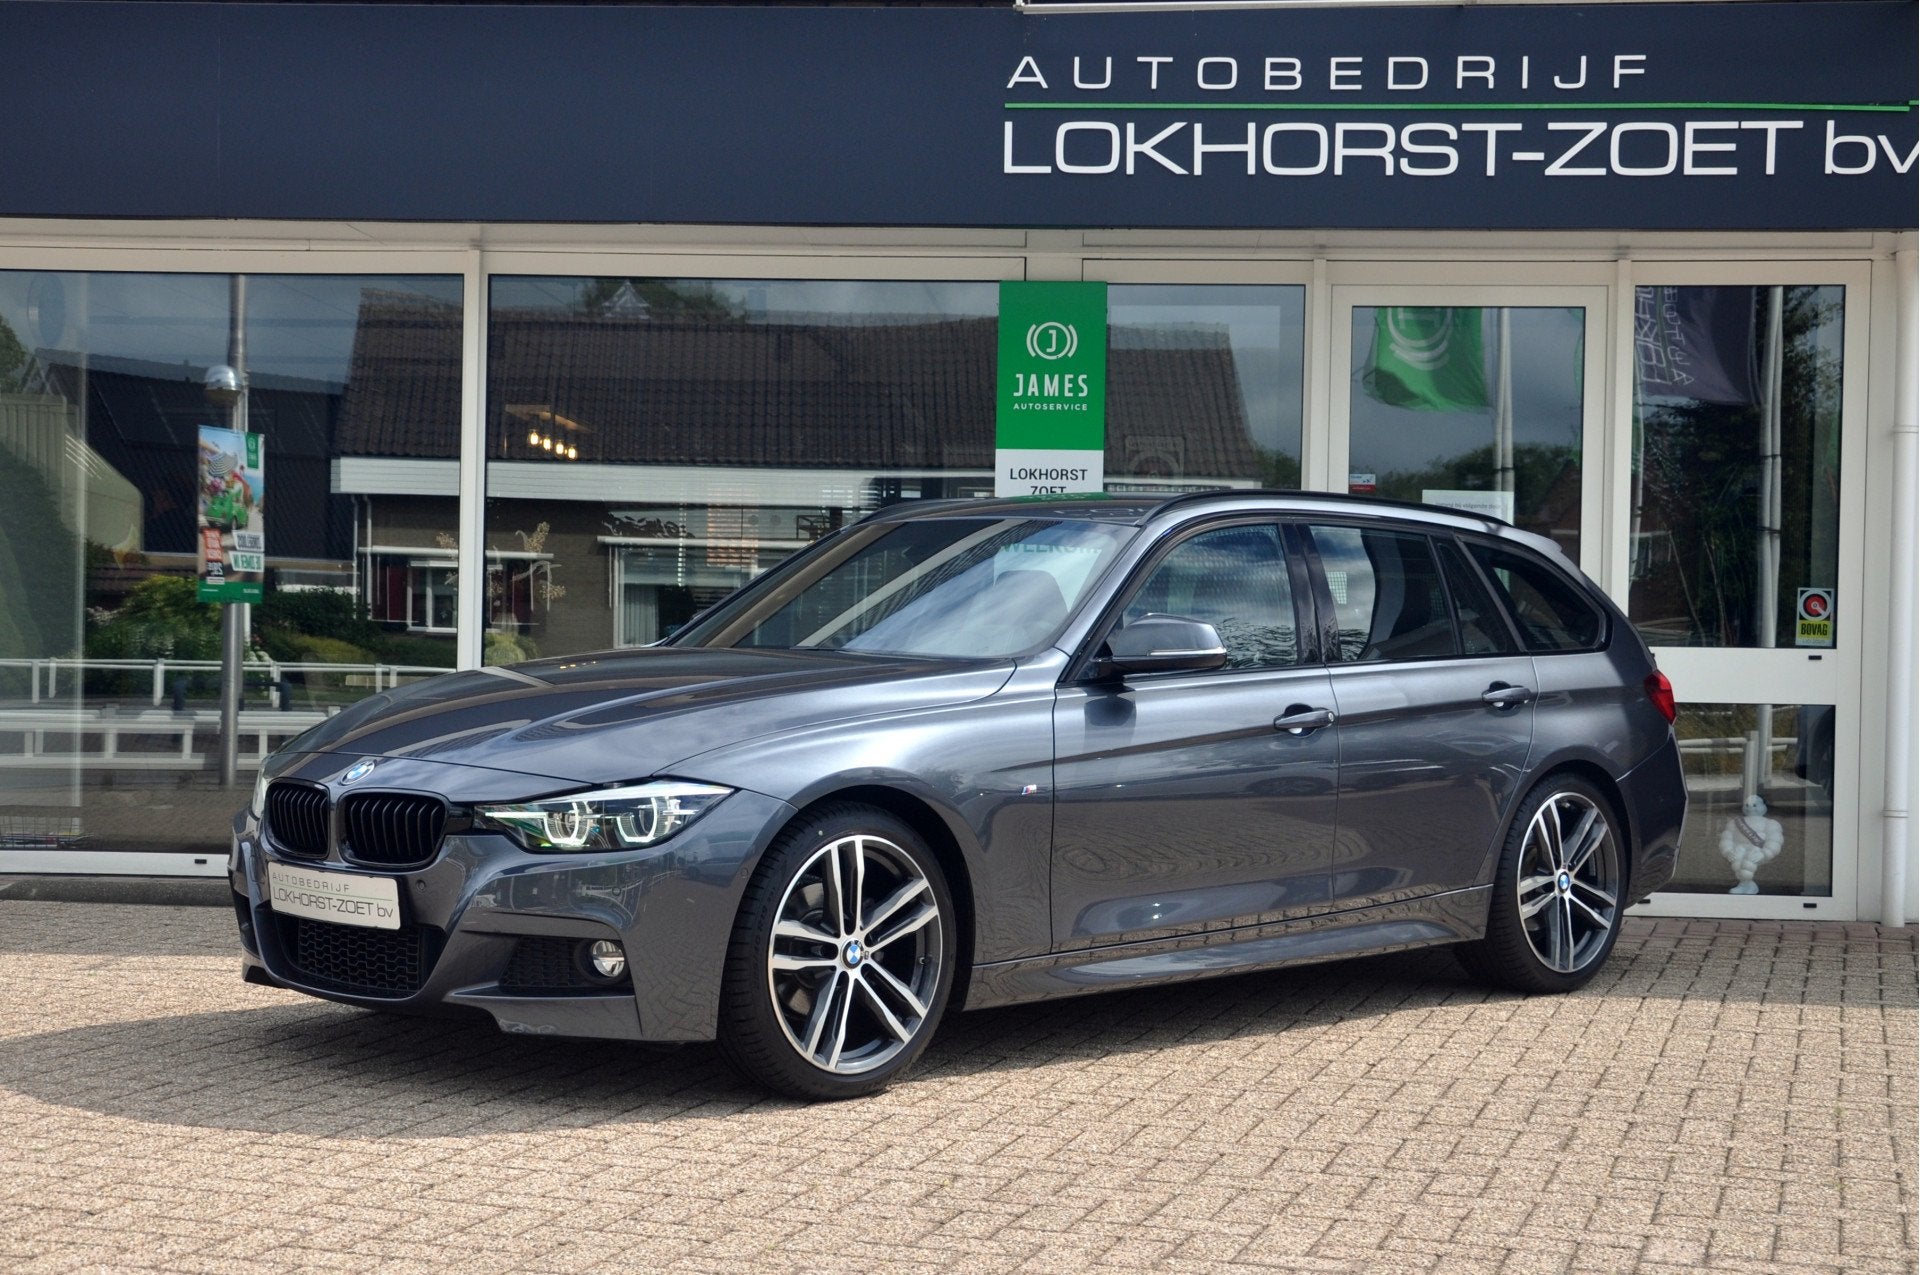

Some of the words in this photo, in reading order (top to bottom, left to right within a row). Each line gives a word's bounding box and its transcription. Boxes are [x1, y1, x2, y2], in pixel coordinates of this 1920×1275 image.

[1007, 54, 1647, 91] AUTOBEDRIJF
[1004, 120, 1804, 177] LOKHORST-ZOET
[1825, 121, 1920, 176] bv
[1013, 373, 1088, 397] JAMES
[1013, 403, 1088, 411] AUTOSERVICE
[1009, 468, 1088, 481] LOKHORST
[1800, 623, 1828, 636] BOVAG
[272, 872, 350, 892] AUTOBEDRIJF
[273, 886, 374, 916] LOKHORST-ZOET
[377, 903, 394, 919] bv
